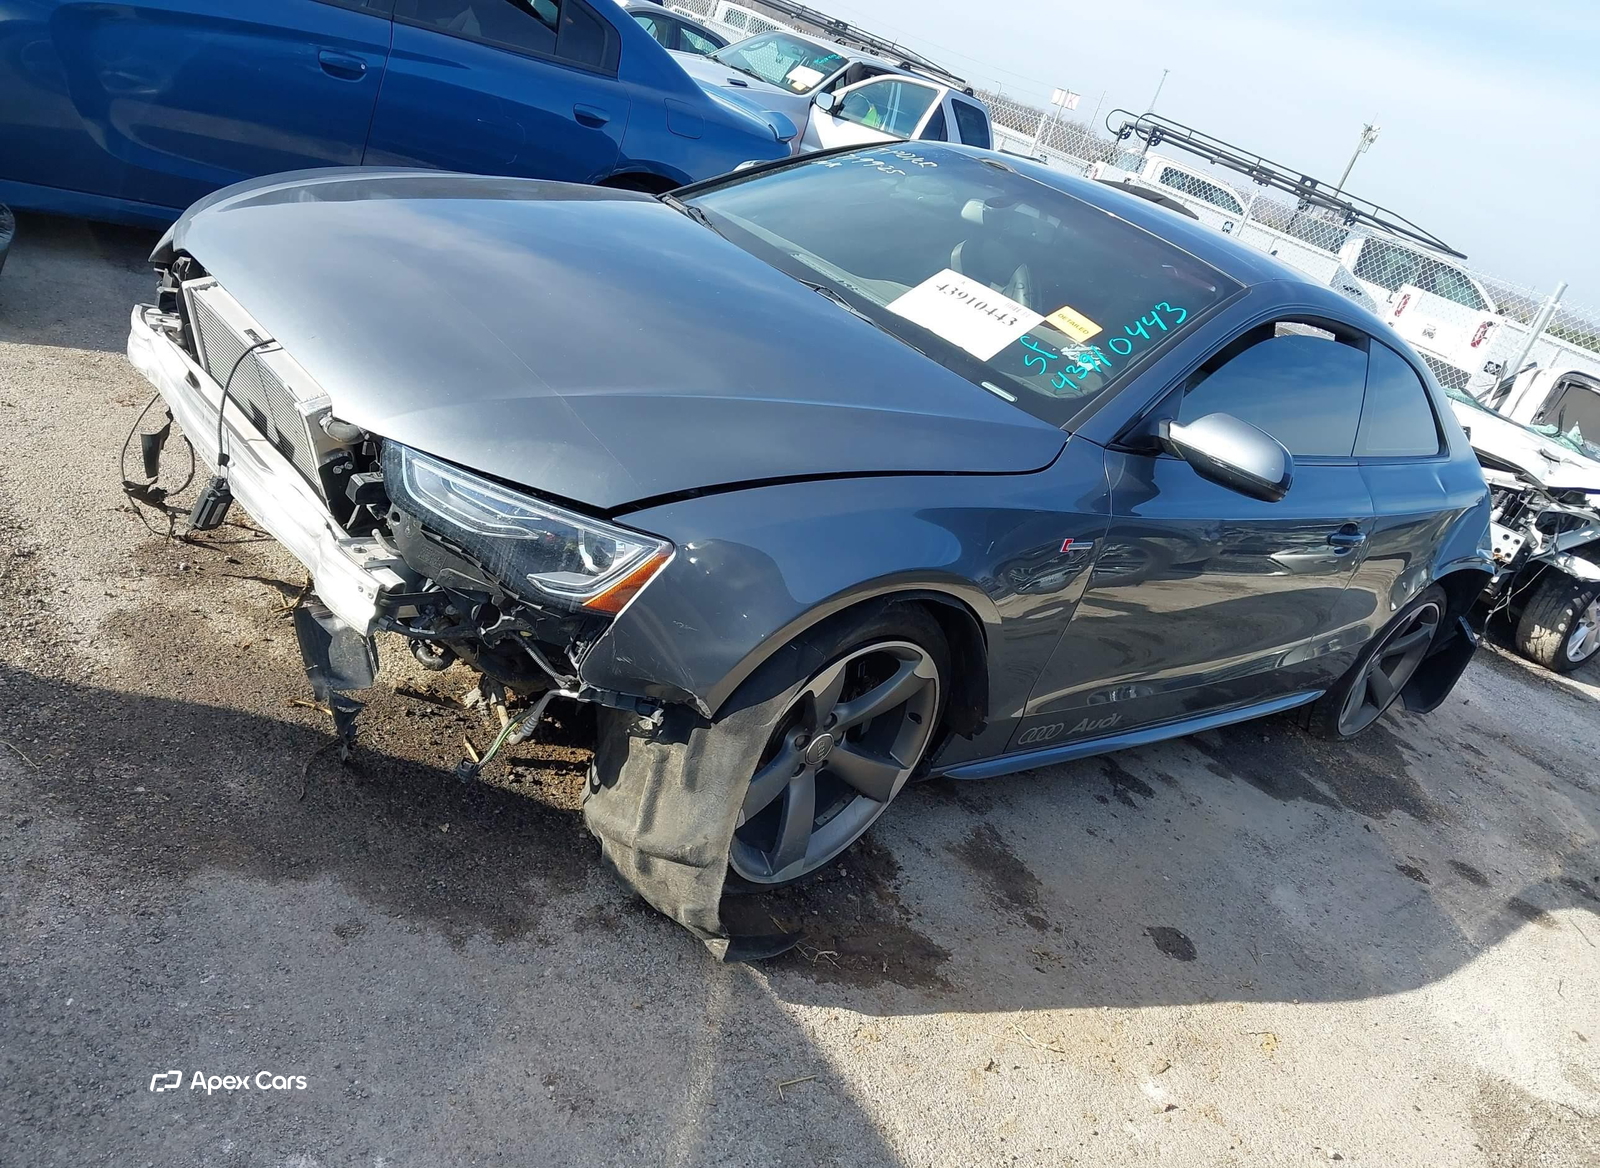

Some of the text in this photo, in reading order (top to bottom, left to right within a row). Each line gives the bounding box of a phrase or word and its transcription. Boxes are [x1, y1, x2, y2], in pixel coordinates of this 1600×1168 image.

[936, 283, 1018, 327] 43910443
[1057, 312, 1090, 335] DETAILED
[1069, 712, 1122, 734] Audi
